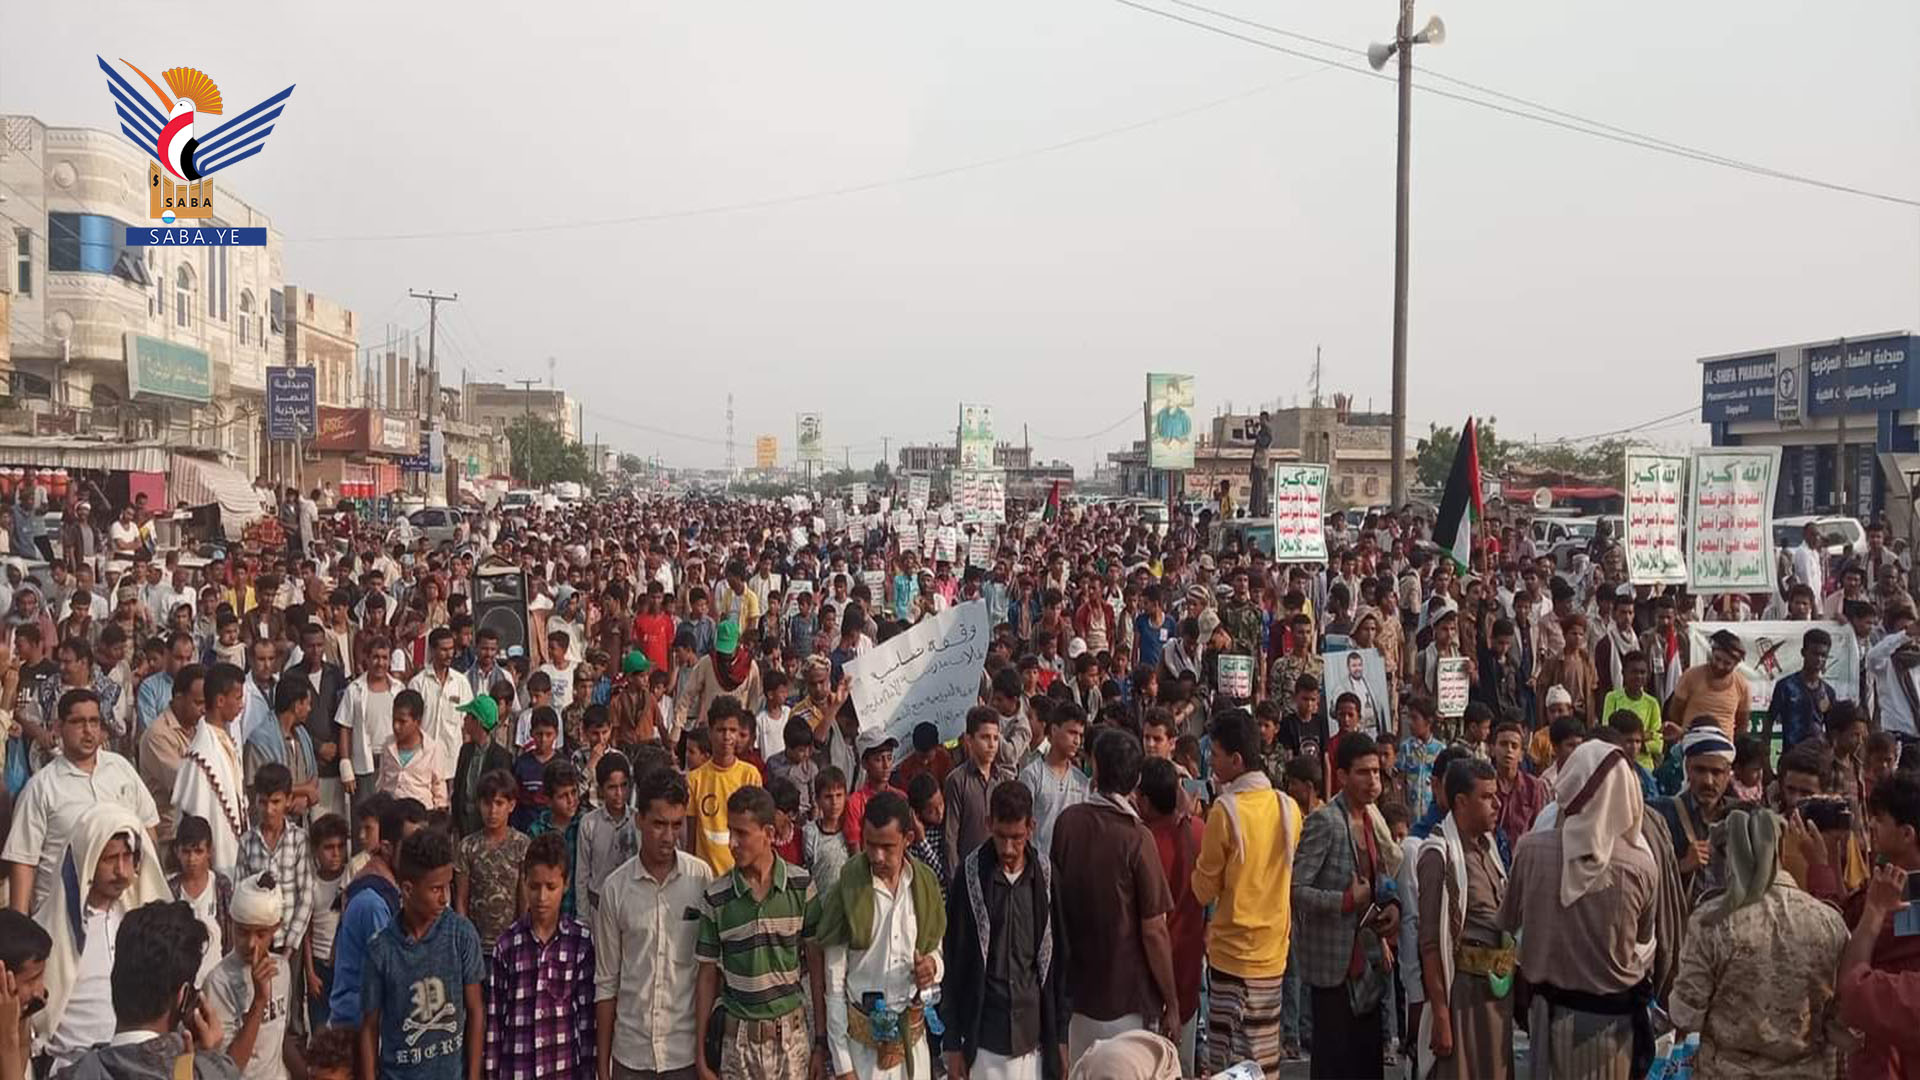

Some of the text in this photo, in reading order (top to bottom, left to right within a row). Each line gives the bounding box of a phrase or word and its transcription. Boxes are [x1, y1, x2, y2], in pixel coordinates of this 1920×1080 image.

[1873, 348, 1905, 370] صيدلية
[274, 379, 309, 389] صيدلية
[275, 392, 309, 402] النصر
[1307, 470, 1323, 486] الله
[1662, 464, 1681, 483] الله
[1742, 462, 1768, 481] الله
